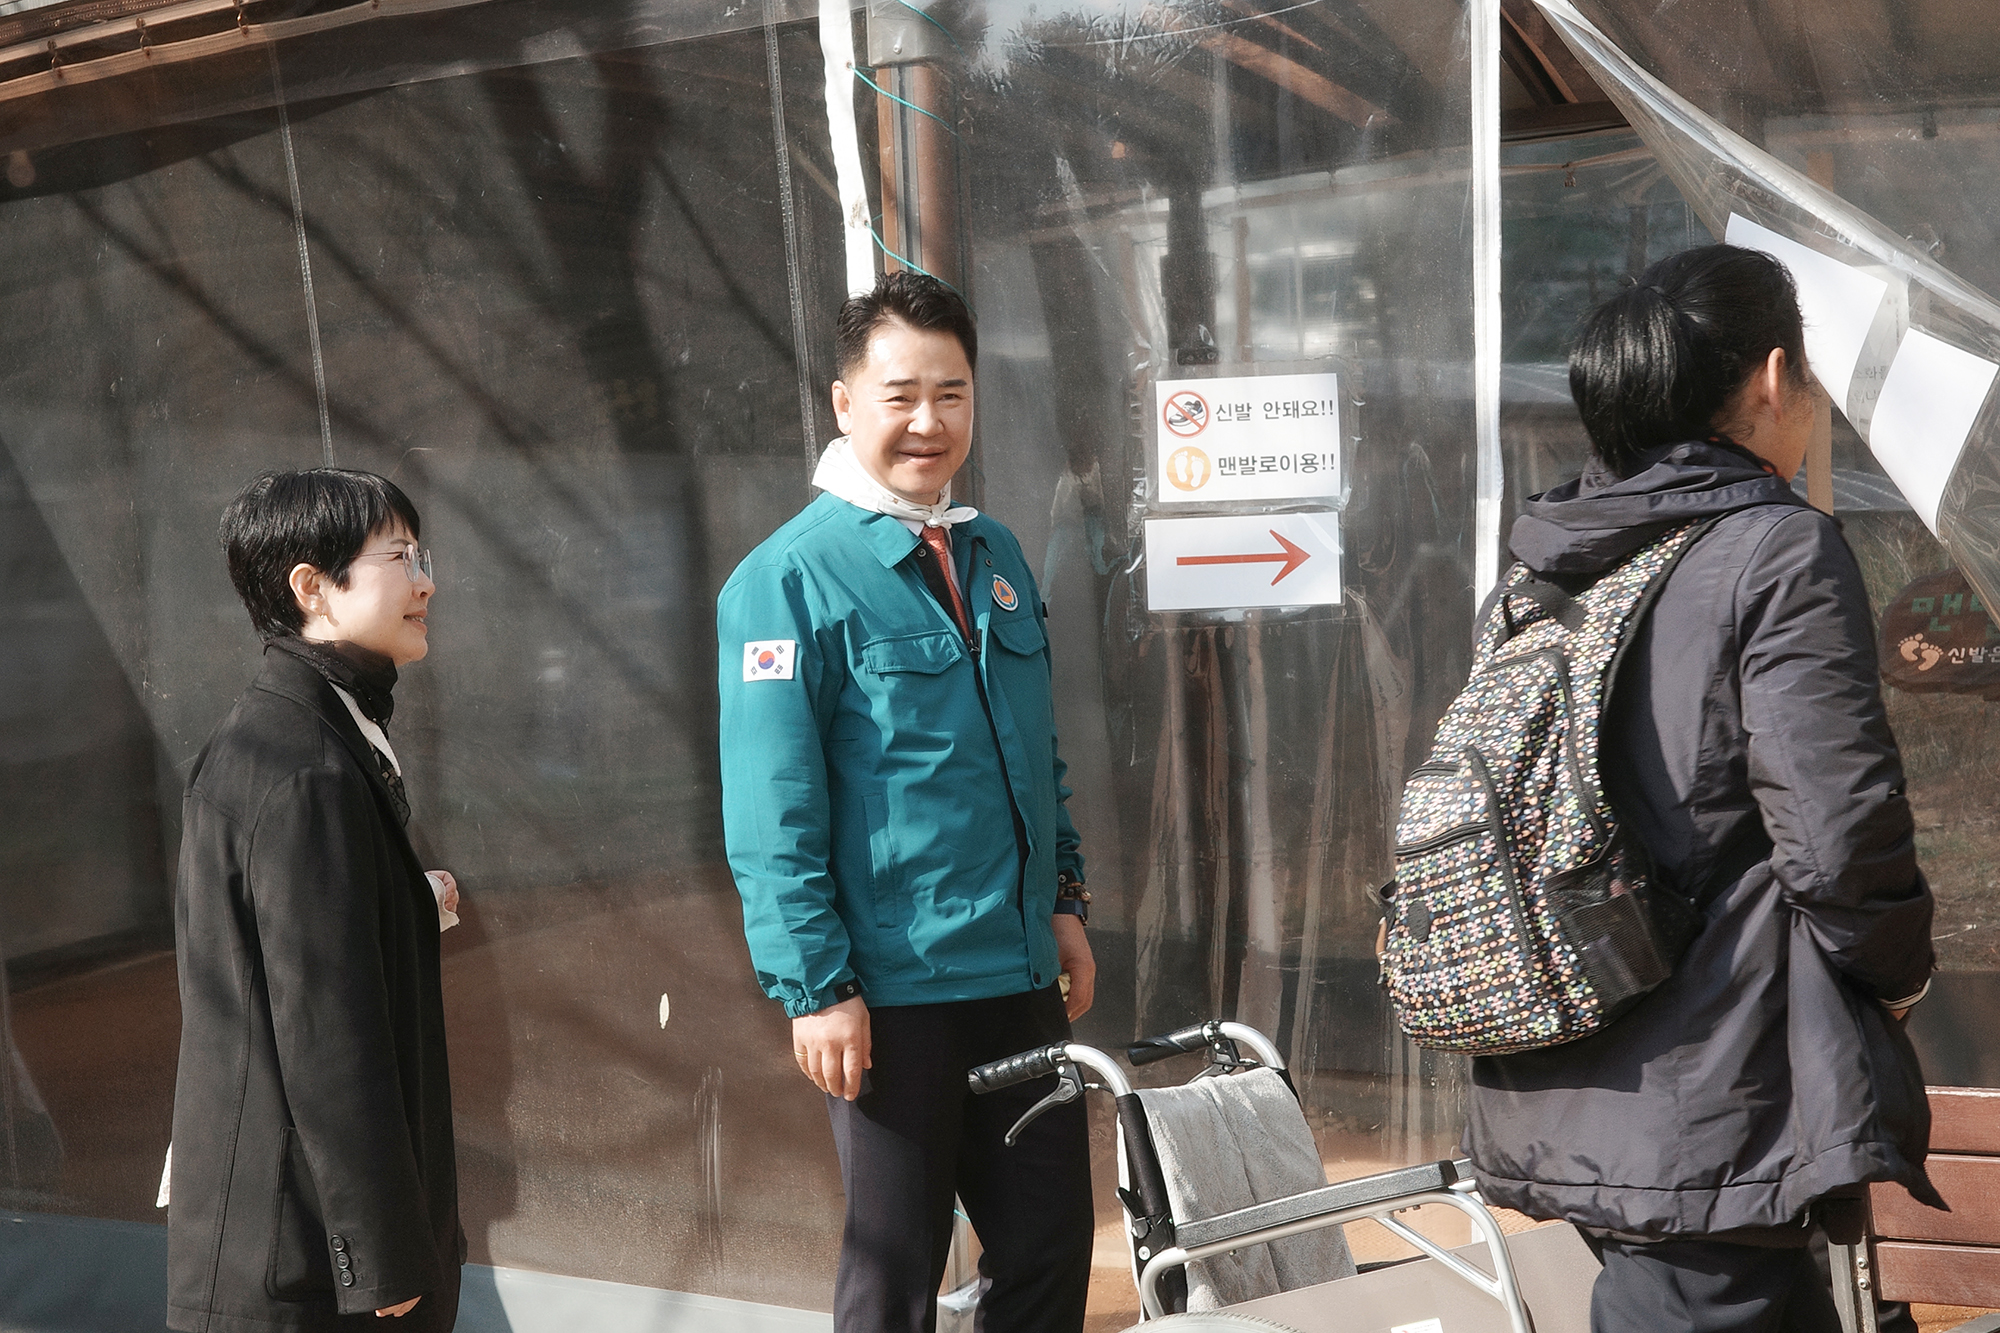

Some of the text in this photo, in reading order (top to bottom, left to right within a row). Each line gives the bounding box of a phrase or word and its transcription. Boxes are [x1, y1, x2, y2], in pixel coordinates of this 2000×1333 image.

[1215, 400, 1334, 421] 신발 안돼요!!
[1218, 453, 1335, 476] 맨발로이용!!
